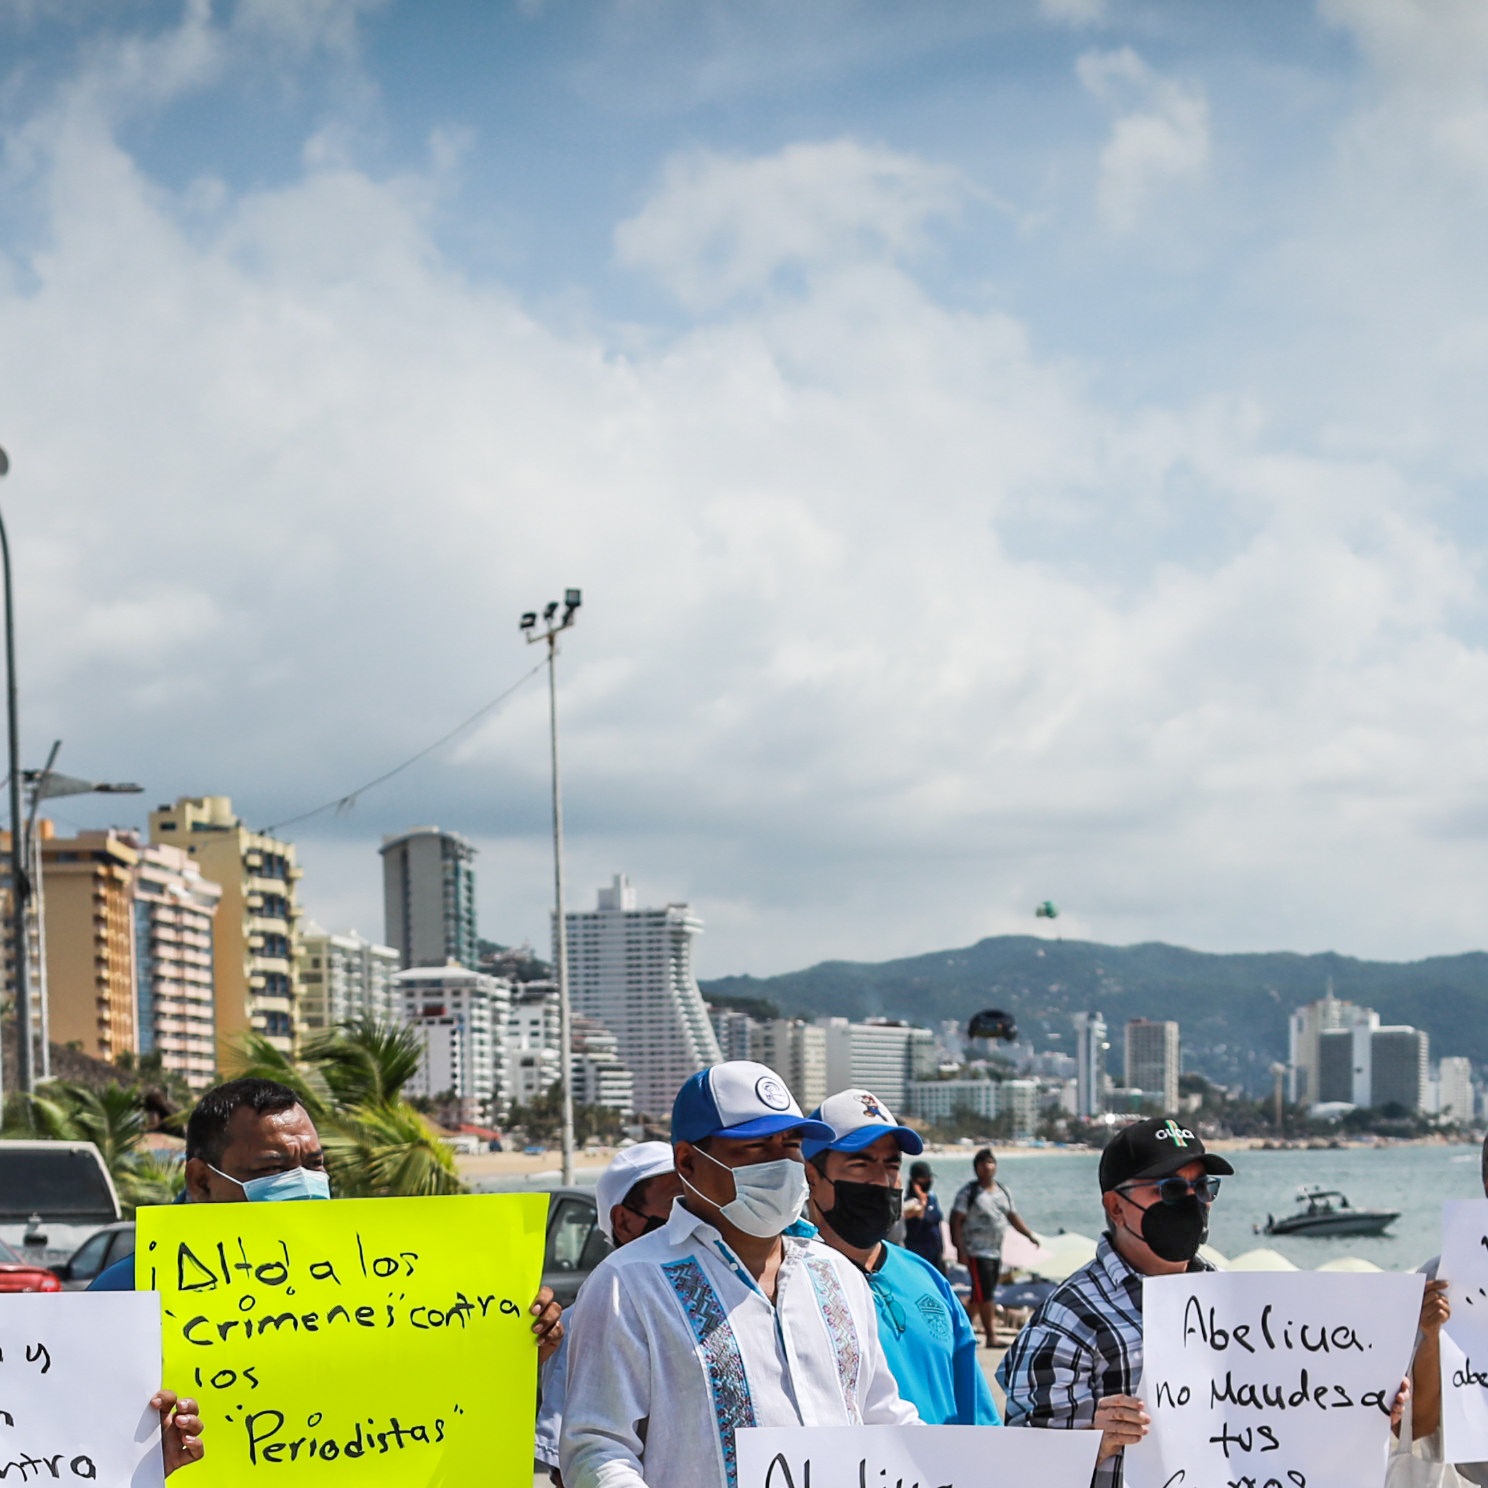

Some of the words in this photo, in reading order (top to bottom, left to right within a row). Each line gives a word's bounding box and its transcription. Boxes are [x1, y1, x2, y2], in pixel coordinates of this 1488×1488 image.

[308, 1261, 342, 1285] a
[355, 1231, 420, 1279] los
[24, 1340, 52, 1374] y
[194, 1366, 260, 1390] los
[1360, 1389, 1392, 1416] a
[1209, 1422, 1281, 1459] tus
